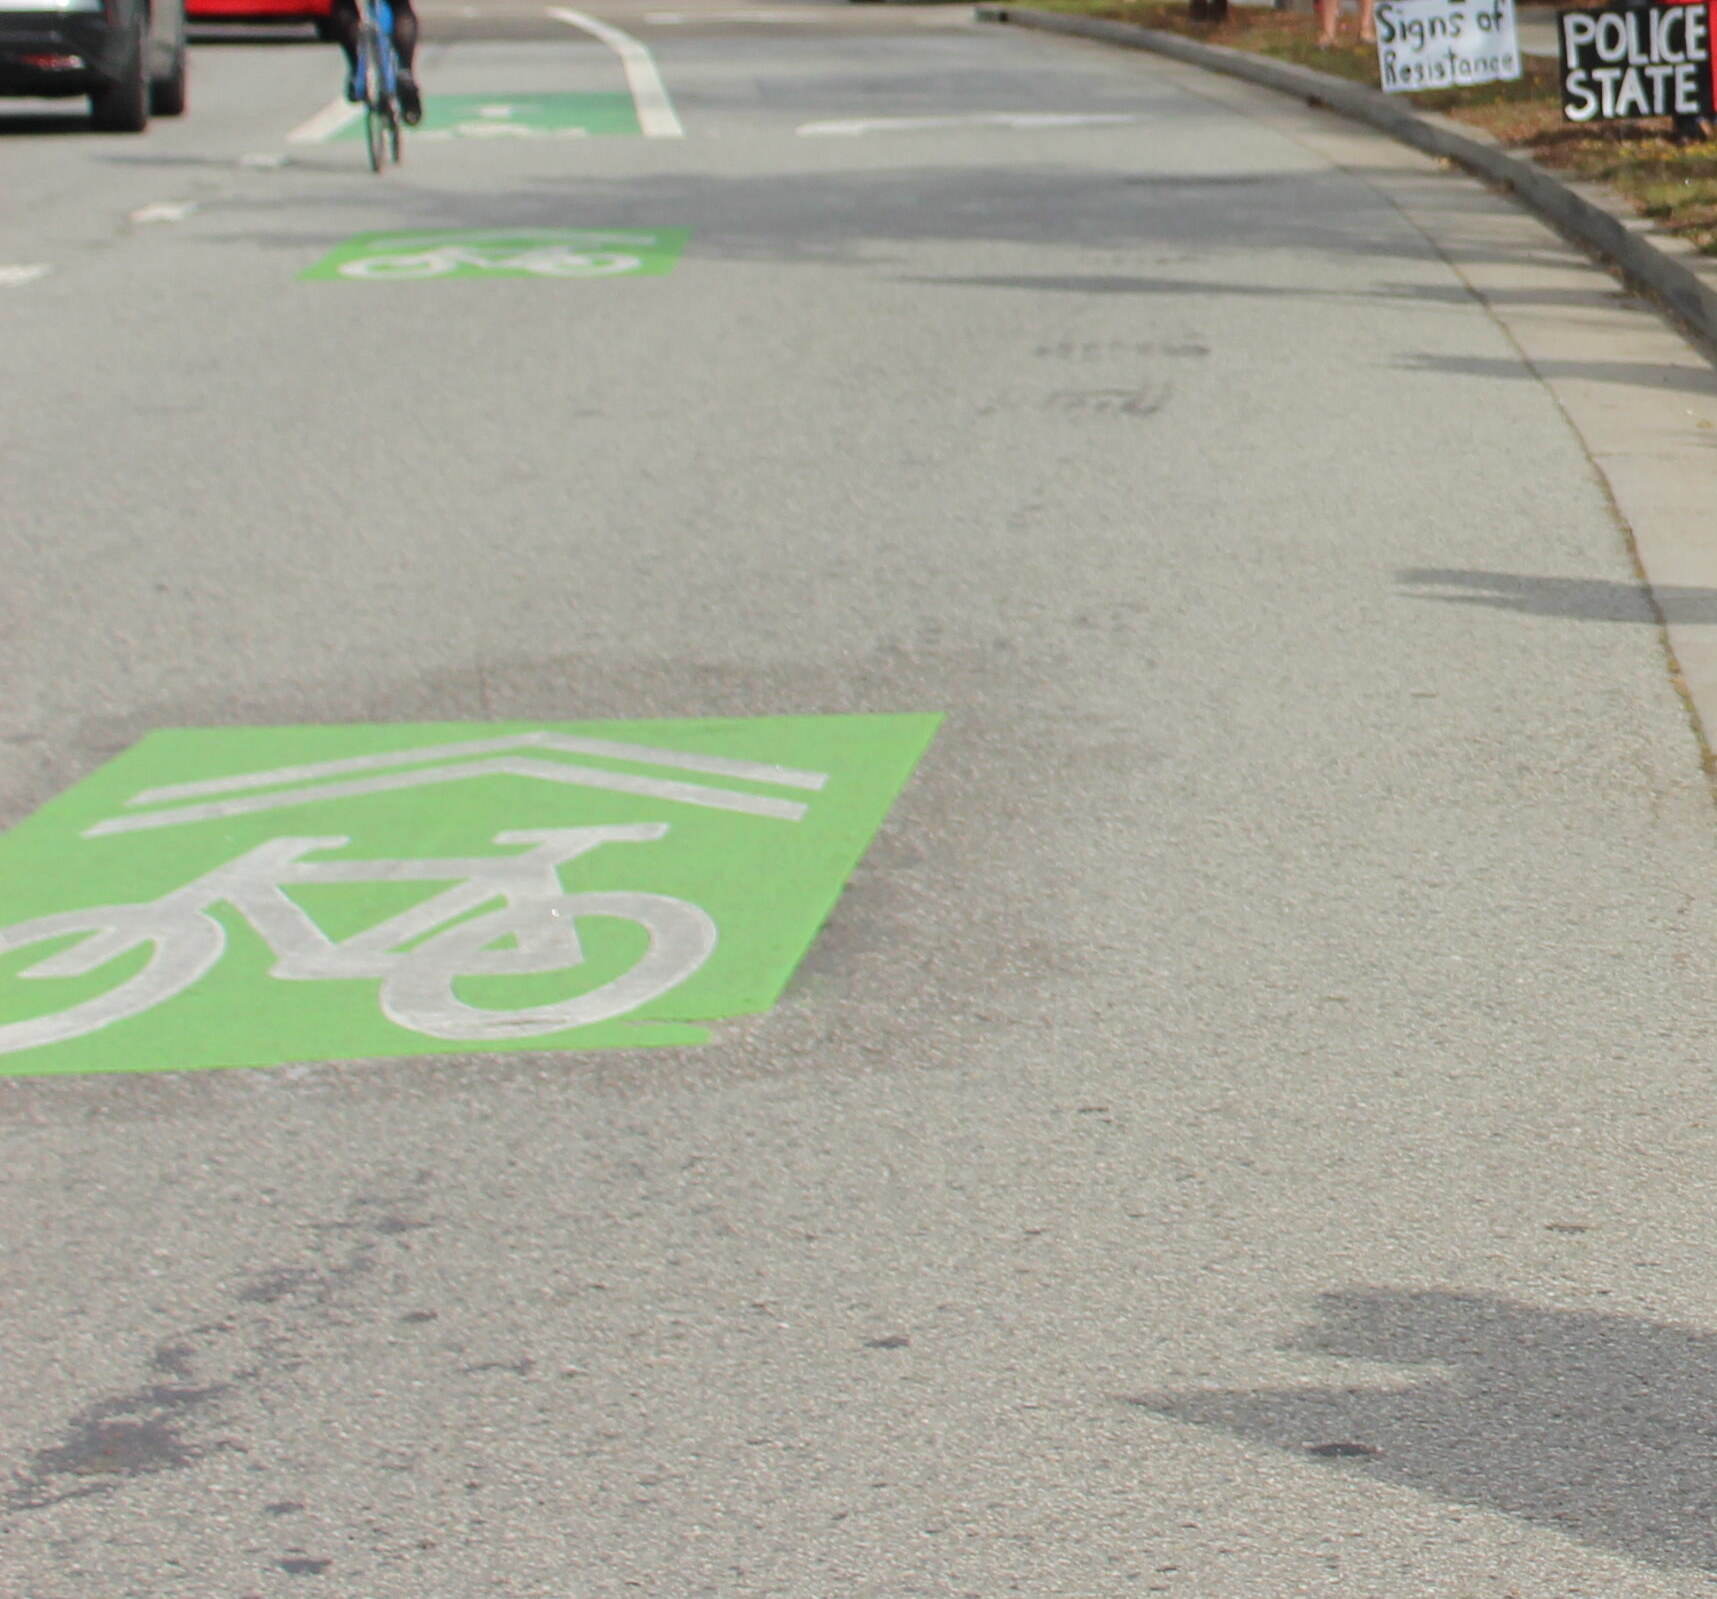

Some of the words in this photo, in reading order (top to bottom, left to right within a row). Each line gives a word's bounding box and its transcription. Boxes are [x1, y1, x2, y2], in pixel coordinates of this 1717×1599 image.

[1375, 5, 1465, 52] Signs
[1562, 6, 1709, 69] POLICE
[1383, 50, 1516, 85] Resistance
[1564, 63, 1700, 123] STATE
